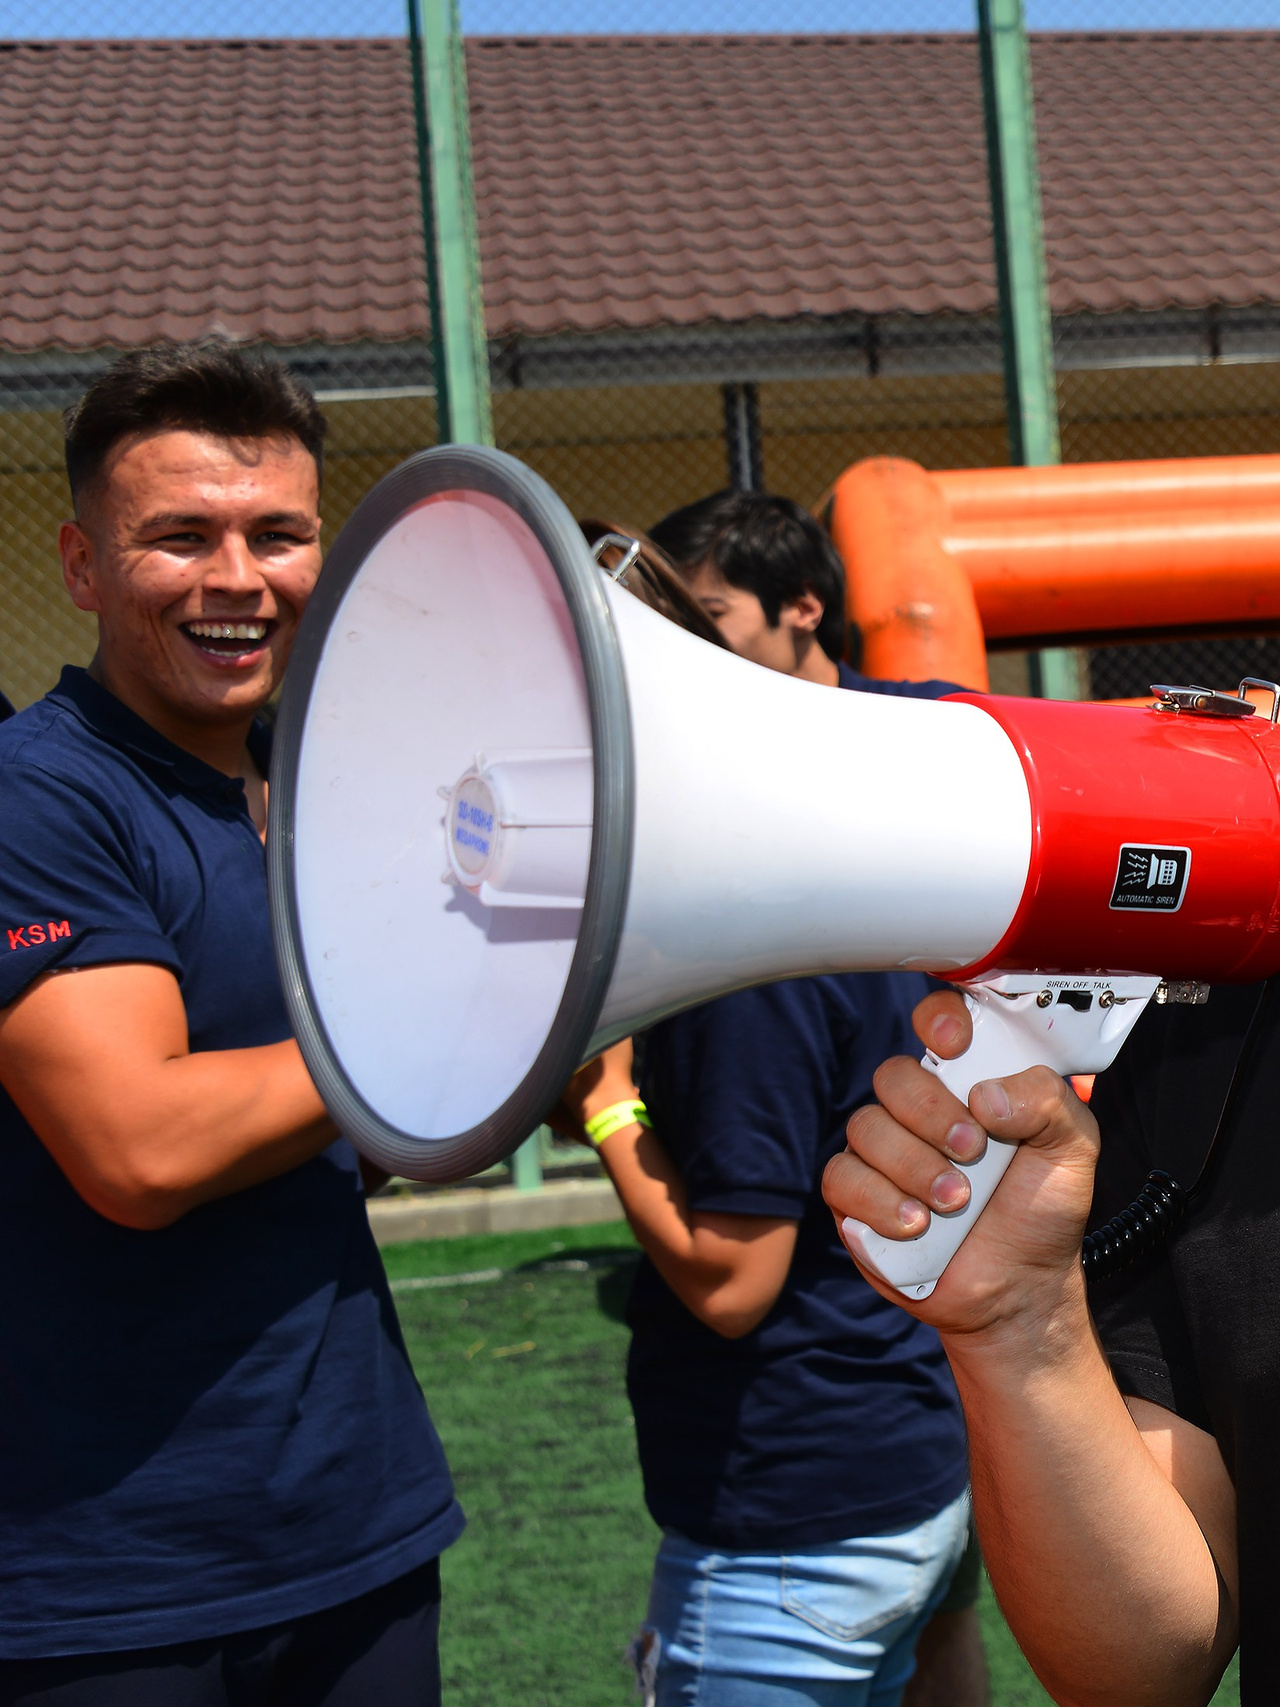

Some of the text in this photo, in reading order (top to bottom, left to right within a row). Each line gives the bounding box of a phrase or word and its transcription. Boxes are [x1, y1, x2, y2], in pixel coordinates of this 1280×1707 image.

[1117, 895, 1175, 905] AUTOMATIC SIREN
[6, 920, 72, 950] KSM
[1046, 980, 1112, 989] SIREN OFF TALK
